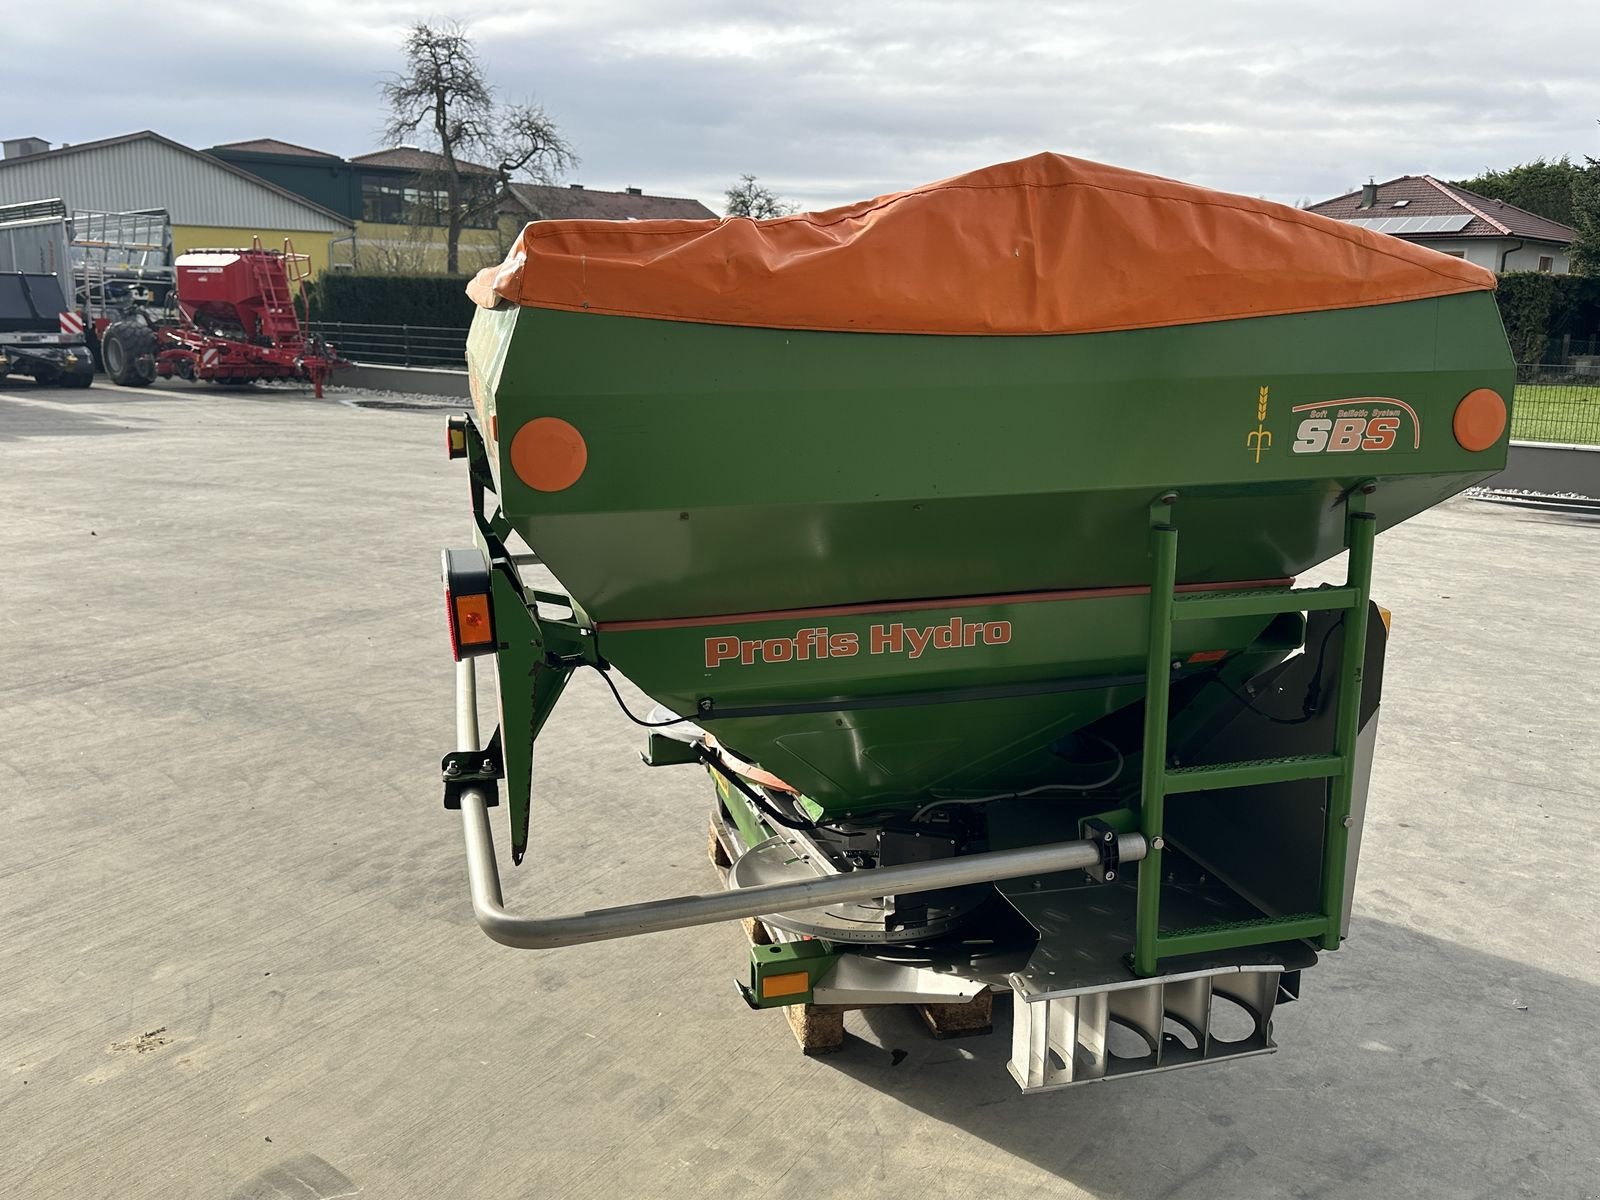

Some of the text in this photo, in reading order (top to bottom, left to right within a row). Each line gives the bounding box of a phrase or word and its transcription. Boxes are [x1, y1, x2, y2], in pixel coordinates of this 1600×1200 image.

[1309, 410, 1328, 418] Soft
[1372, 408, 1401, 418] System
[1292, 417, 1401, 453] SBS
[704, 617, 1012, 668] Profis Hydro
